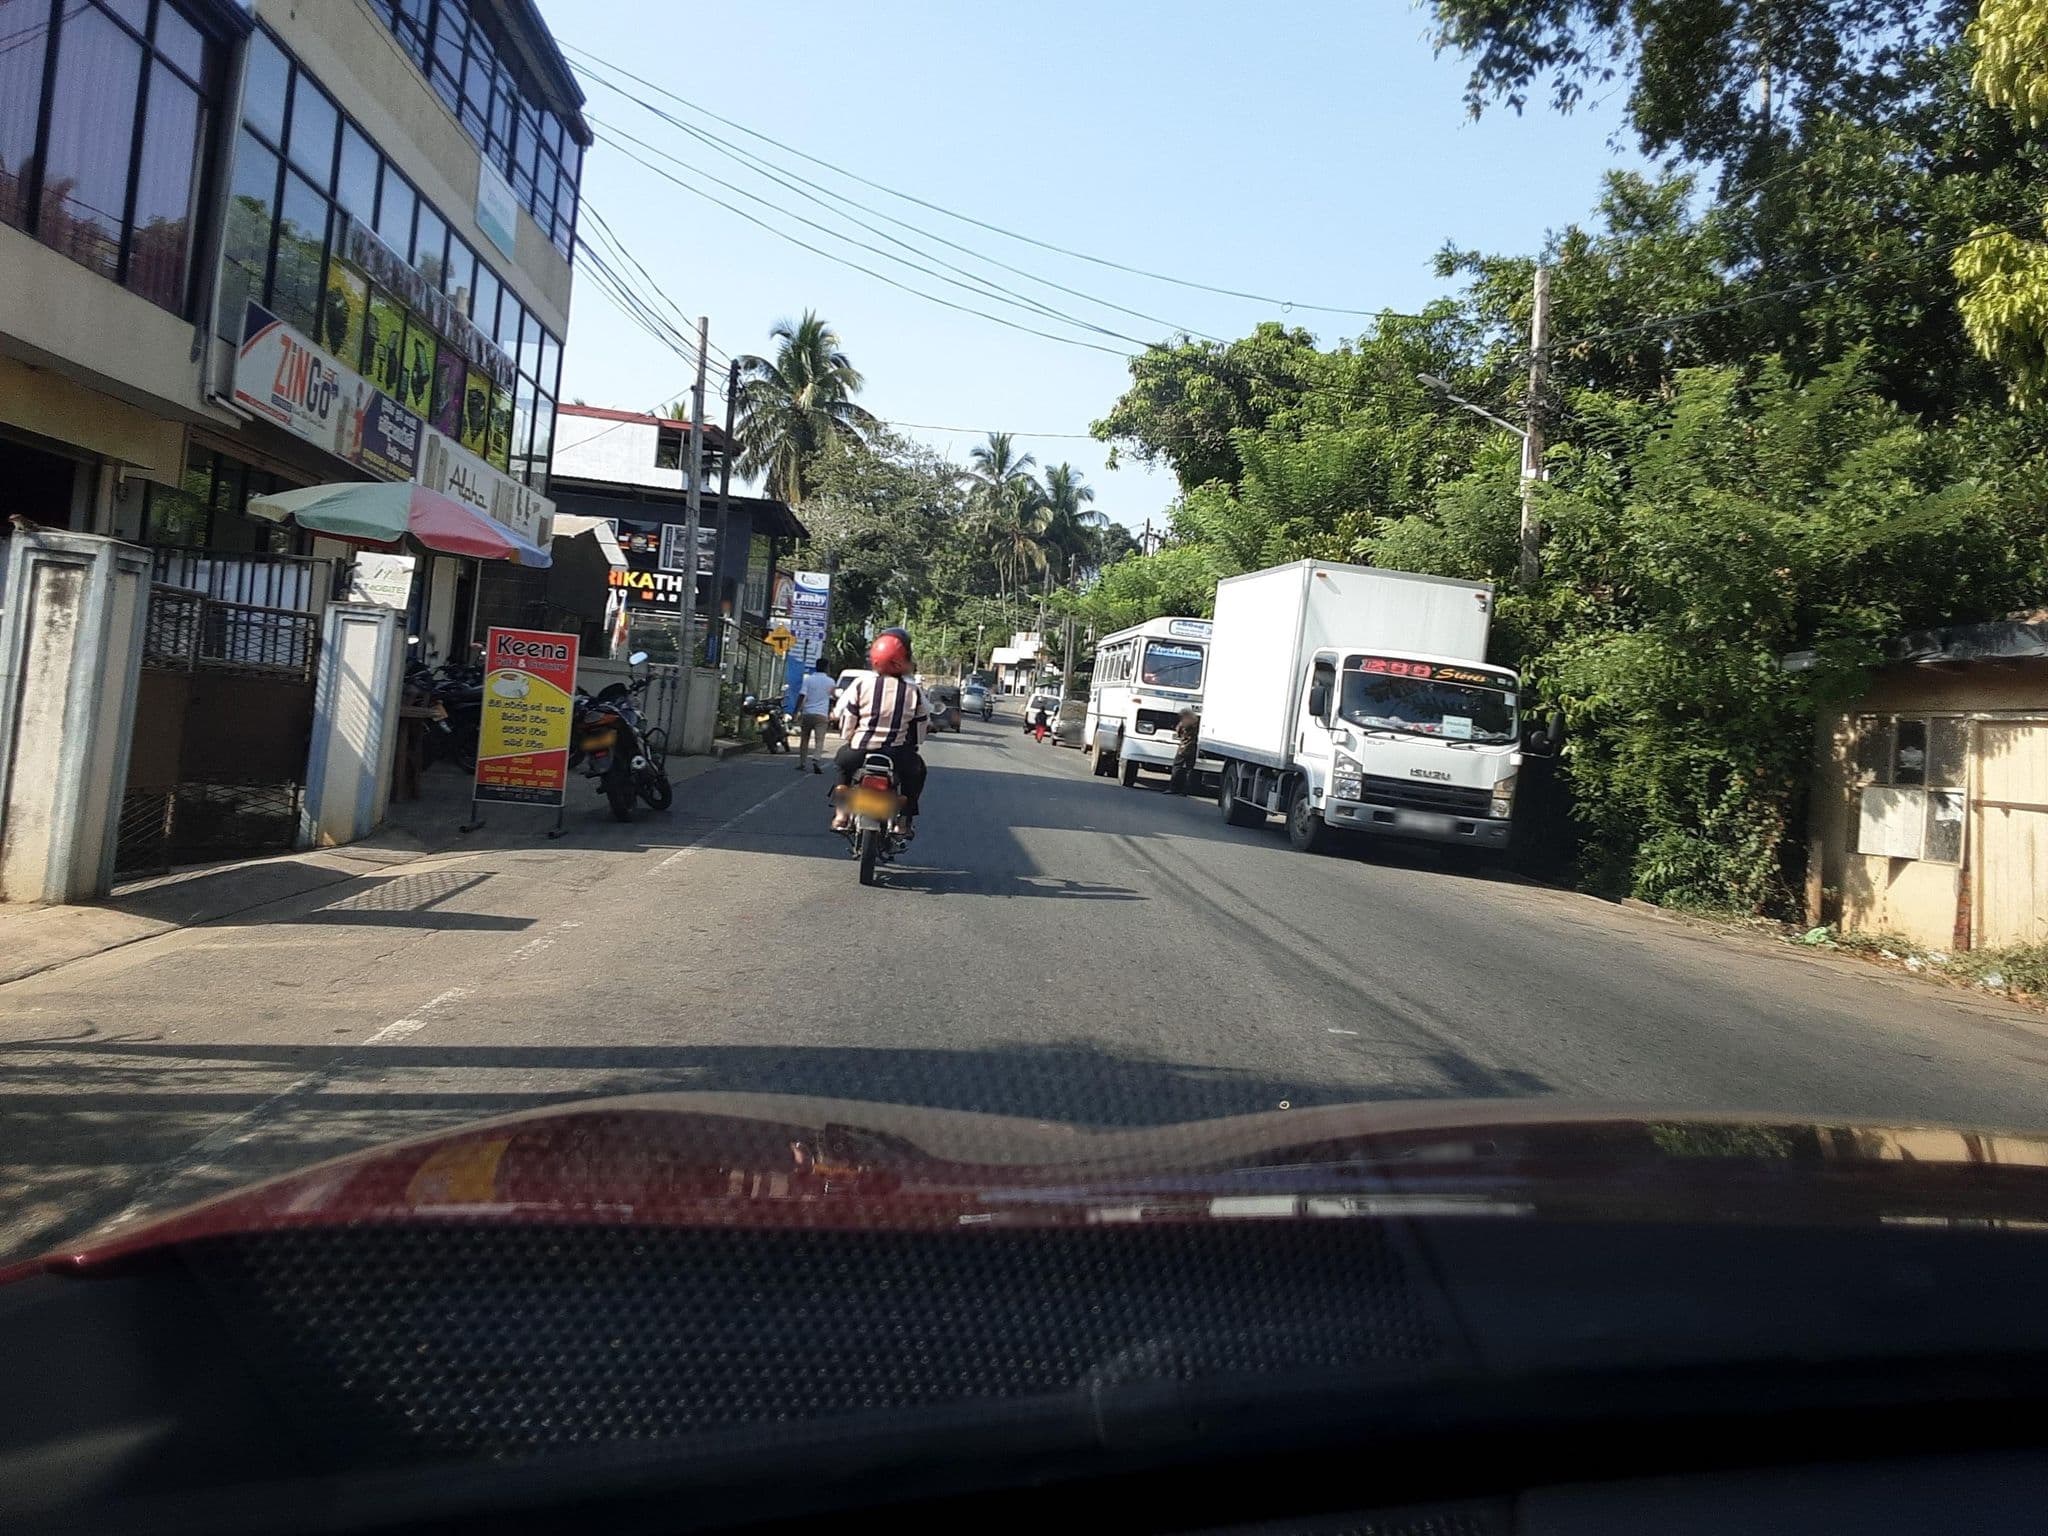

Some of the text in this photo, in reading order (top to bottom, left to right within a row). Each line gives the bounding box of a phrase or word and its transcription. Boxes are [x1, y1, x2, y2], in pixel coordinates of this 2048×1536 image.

[449, 464, 487, 509] Alpha
[497, 635, 569, 660] Keena
[1410, 768, 1451, 781] ISUZU
